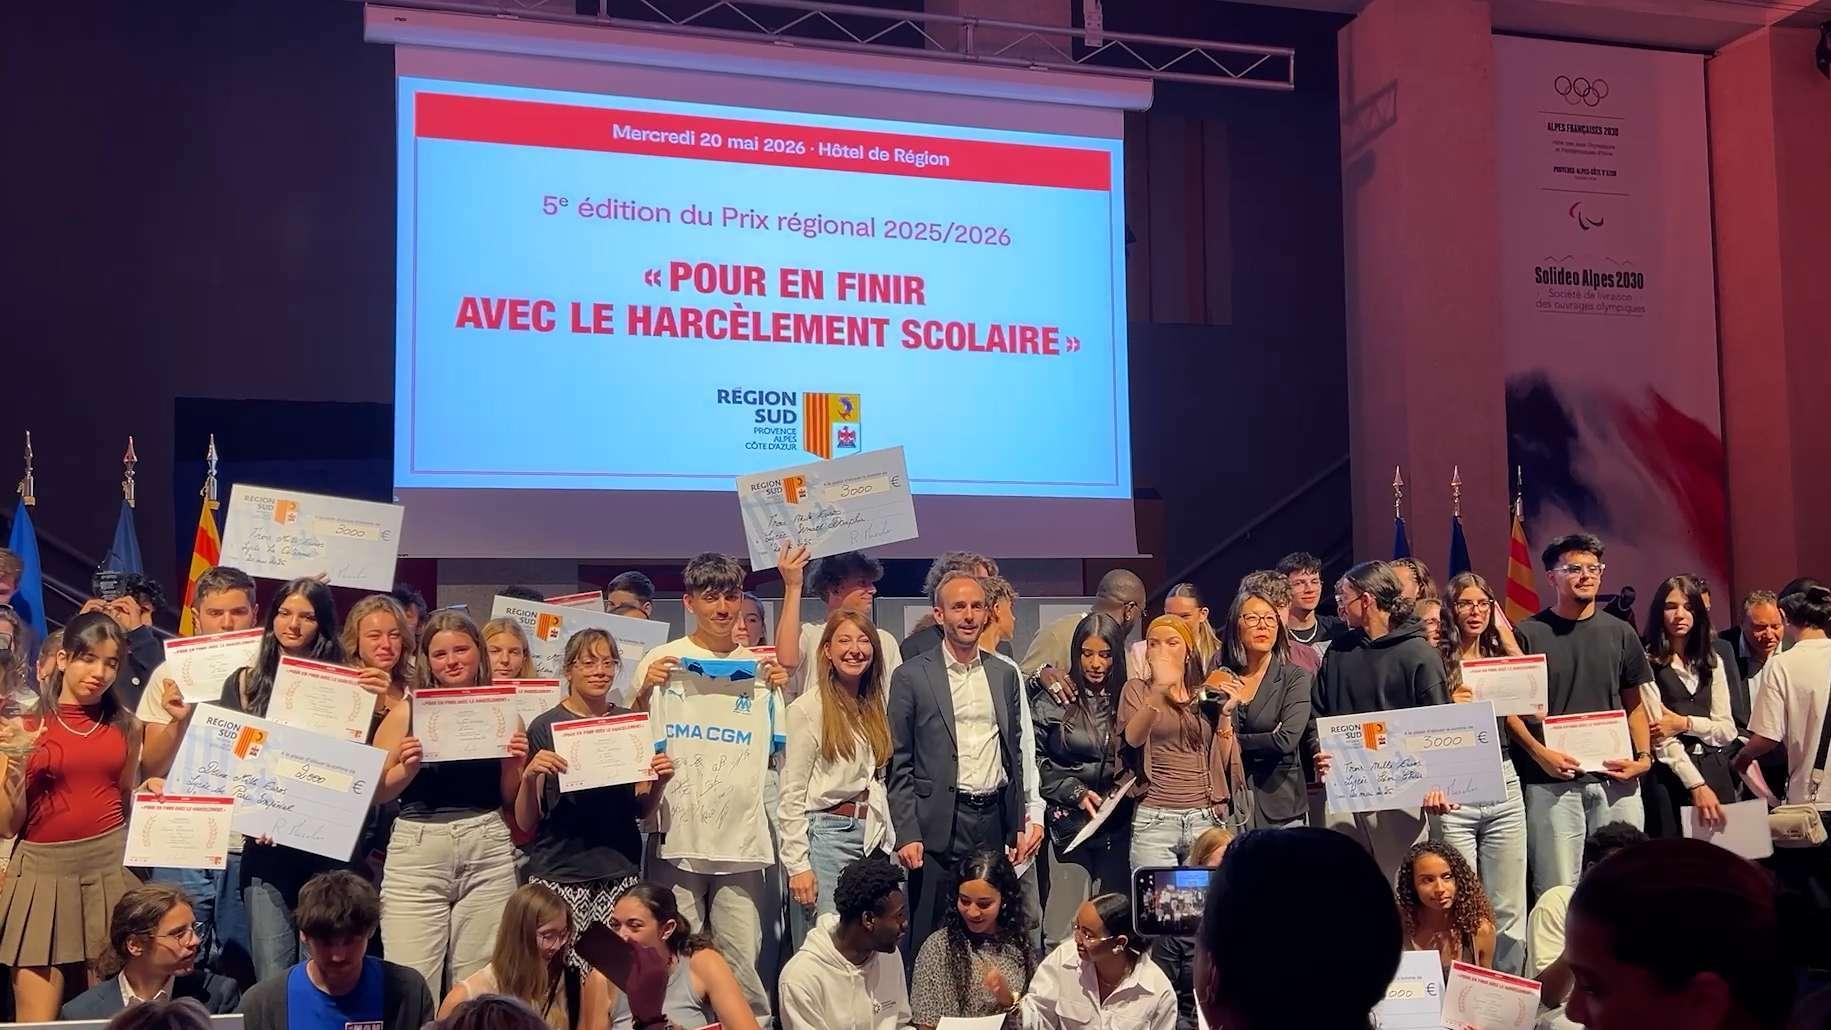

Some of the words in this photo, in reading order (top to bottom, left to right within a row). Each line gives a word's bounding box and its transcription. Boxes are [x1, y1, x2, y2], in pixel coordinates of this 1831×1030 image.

[612, 124, 695, 146] Mercredi
[700, 132, 722, 148] 20
[728, 135, 759, 151] mai
[764, 138, 805, 155] 2026
[818, 140, 864, 161] Hôtel
[868, 146, 889, 162] de
[894, 147, 950, 168] Région
[578, 196, 671, 224] édition
[680, 203, 713, 227] du
[722, 206, 769, 231] Prix
[778, 213, 876, 239] régional
[884, 219, 1011, 247] 2025/2026
[670, 261, 767, 297] POUR
[779, 267, 824, 300] EN
[837, 271, 926, 306] FINIR
[1535, 266, 1580, 286] Solideo
[1582, 269, 1615, 291] Alpes
[1615, 271, 1644, 290] 2030
[455, 296, 556, 333] AVEC
[571, 301, 615, 335] LE
[627, 302, 890, 347] HARCÈLEMENT
[901, 319, 1060, 356] SCOLAIRE
[754, 409, 797, 424] SUD
[754, 427, 797, 435] PROVENCE
[773, 435, 797, 443] ALPES
[745, 441, 766, 450] CÔTE
[768, 442, 797, 451] D'AZUR
[766, 487, 783, 496] SUD
[840, 484, 873, 497] 3000
[257, 504, 275, 512] SUD
[335, 524, 366, 537] 3000
[519, 617, 537, 626] SUD
[218, 728, 238, 740] SUD
[665, 724, 702, 740] CMA
[706, 726, 752, 746] CGM
[1477, 731, 1489, 744] €
[1423, 736, 1463, 749] 3000
[352, 780, 367, 795] €
[1426, 982, 1437, 997] €
